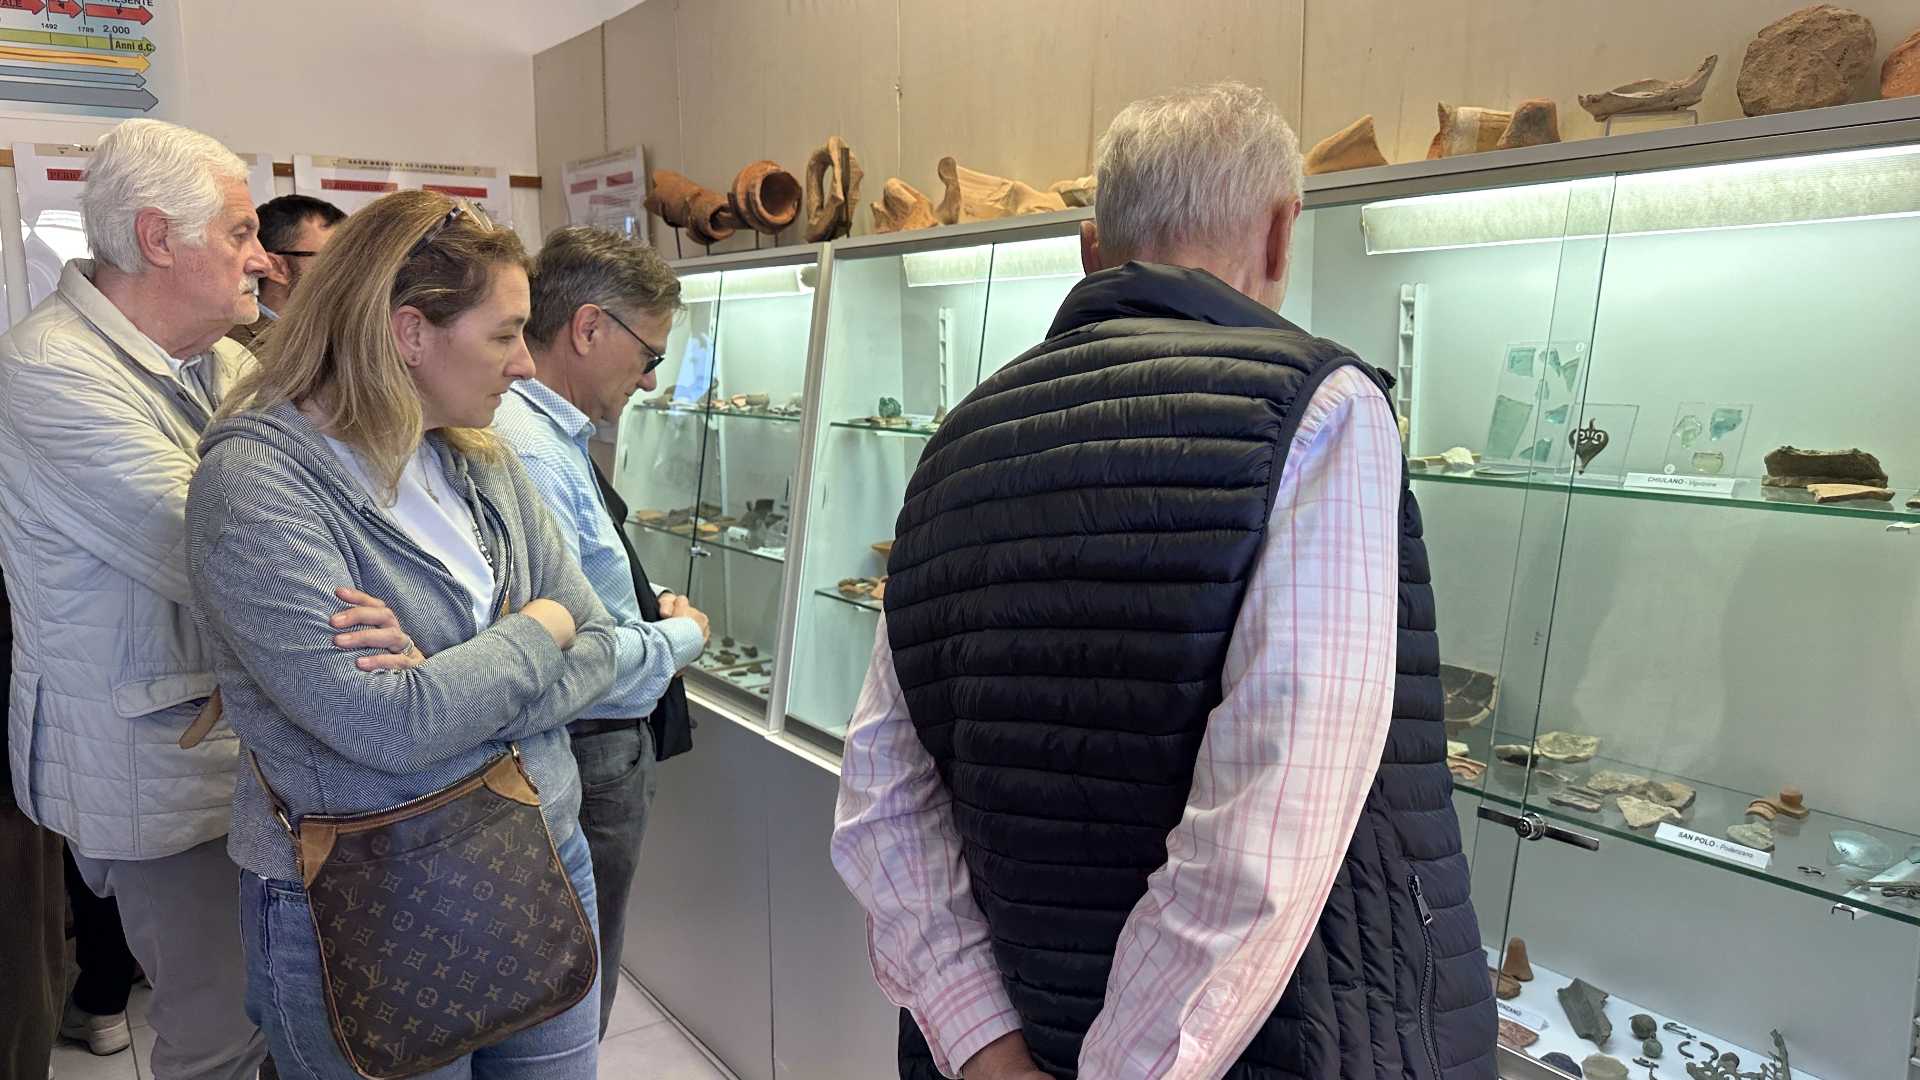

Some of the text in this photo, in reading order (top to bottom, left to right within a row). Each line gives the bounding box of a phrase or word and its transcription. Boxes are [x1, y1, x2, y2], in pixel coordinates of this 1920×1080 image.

[103, 24, 130, 35] 2.000
[115, 40, 135, 50] Anni
[1678, 831, 1693, 841] SAN
[1694, 836, 1716, 847] POLO
